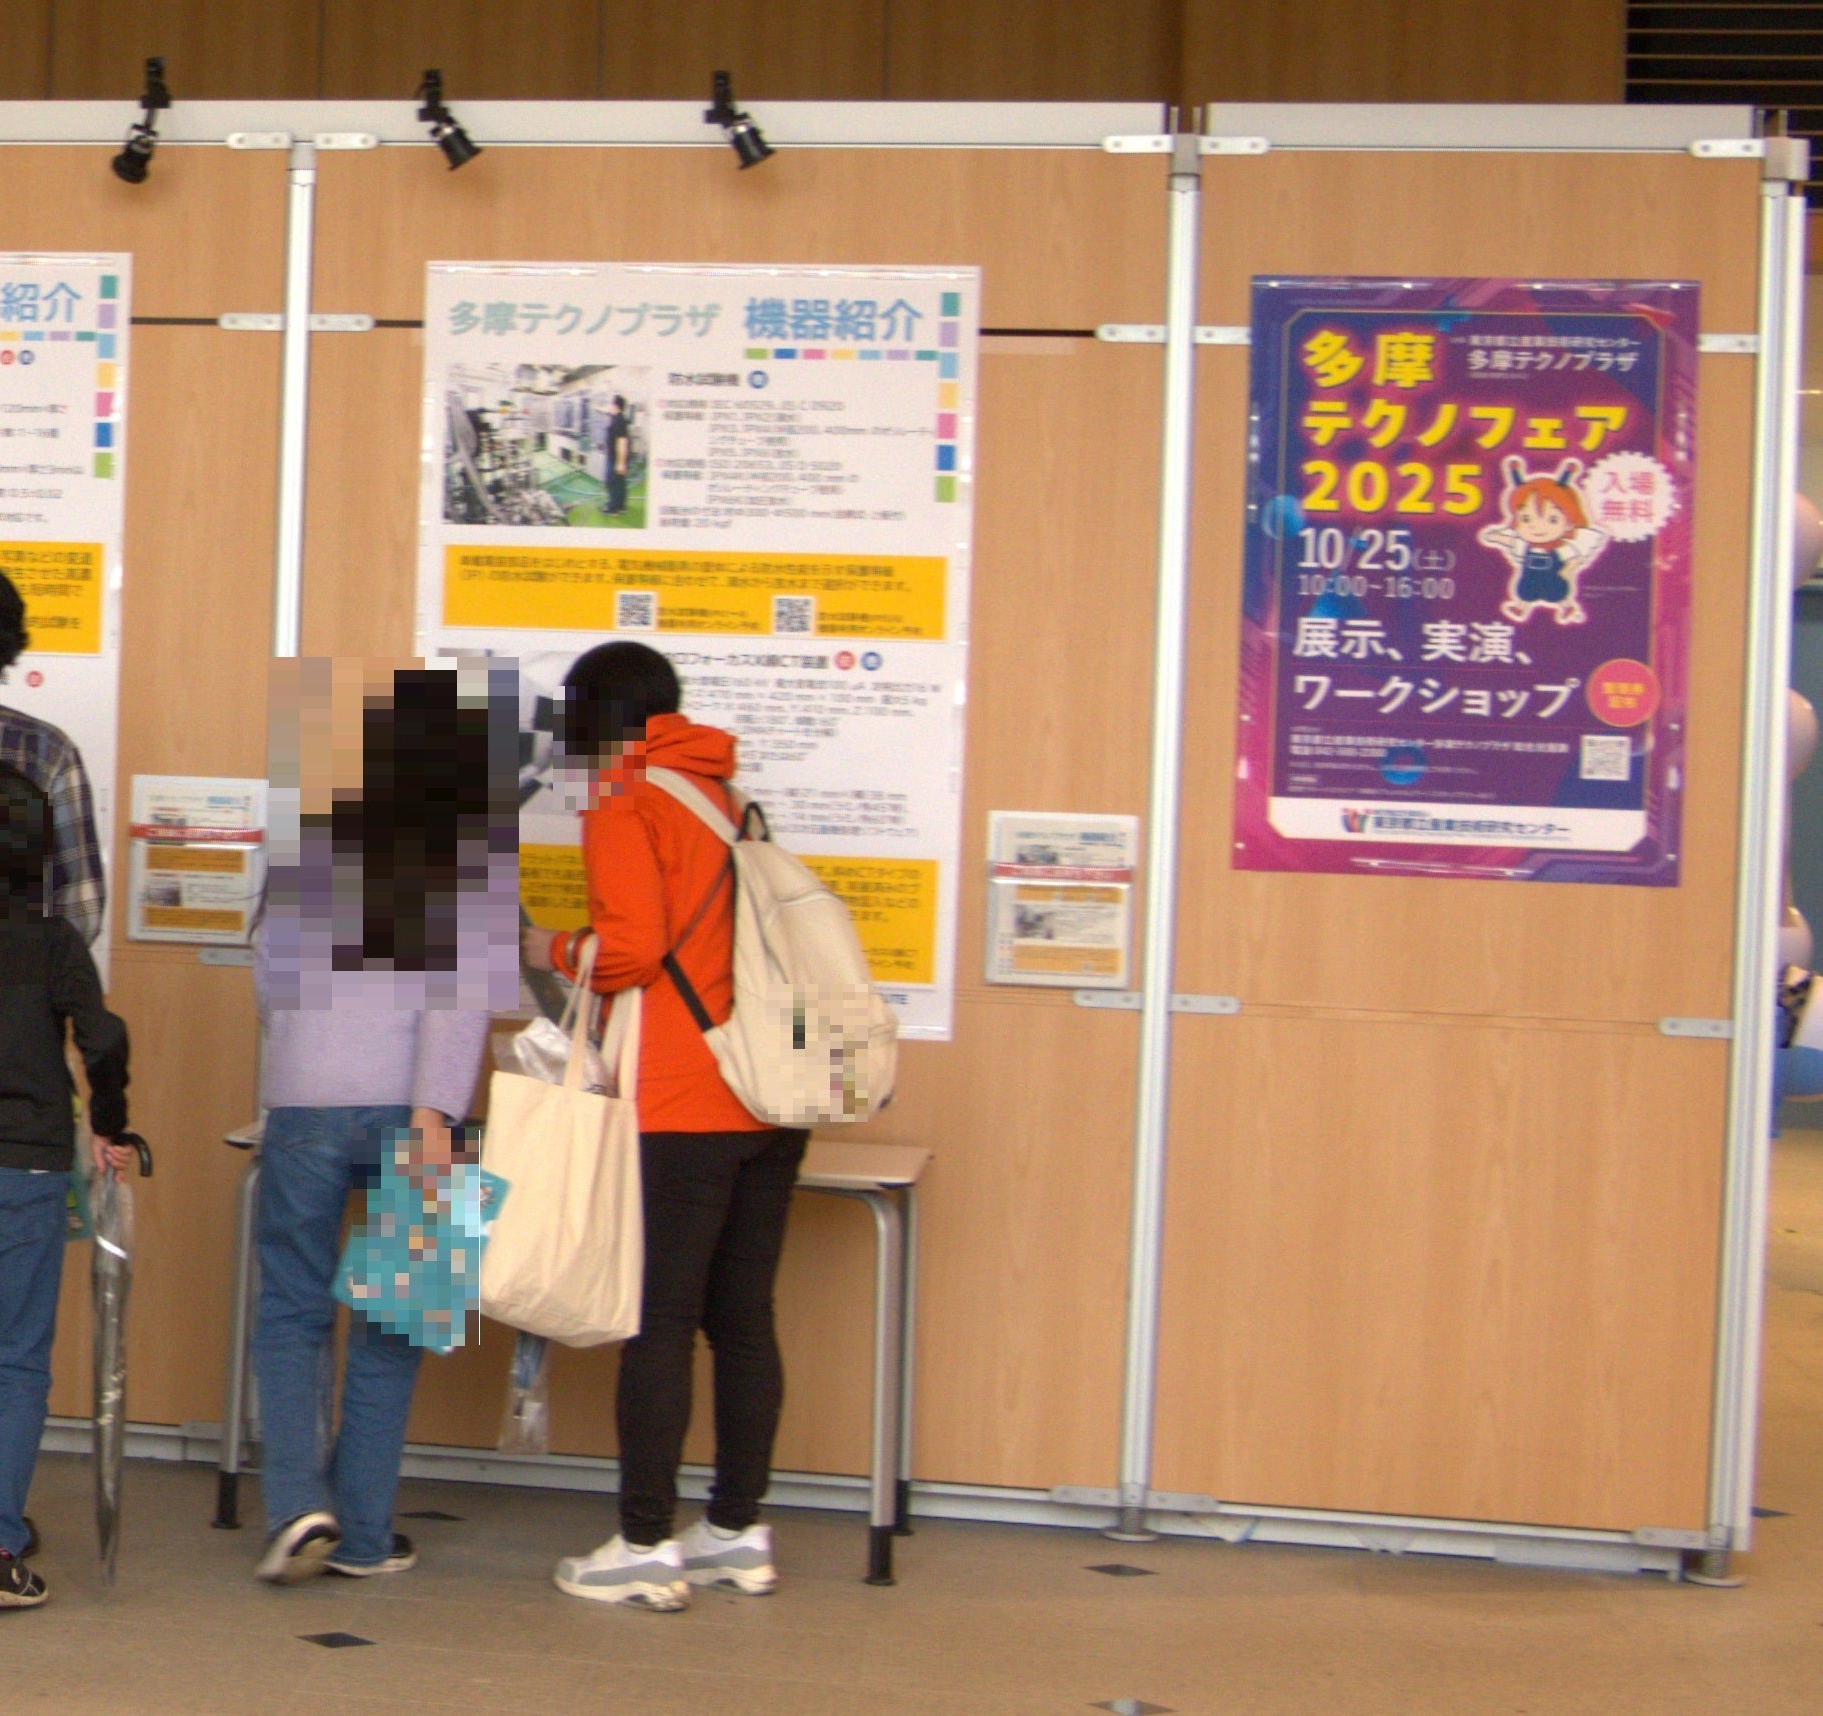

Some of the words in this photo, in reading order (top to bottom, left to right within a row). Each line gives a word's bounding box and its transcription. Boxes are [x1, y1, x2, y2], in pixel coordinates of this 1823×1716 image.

[448, 298, 721, 337] 多摩テクノプラザ
[744, 296, 924, 342] 機器紹介
[1303, 331, 1435, 388] 多摩
[1466, 349, 1640, 372] 多摩テクノプラザ
[1302, 399, 1628, 451] テクノフェア
[1301, 460, 1484, 514] 2025
[1601, 471, 1654, 497] 入場
[1601, 498, 1654, 522] 無料
[1293, 617, 1533, 665] 展示、実演、
[1293, 675, 1581, 719] ワークショップ
